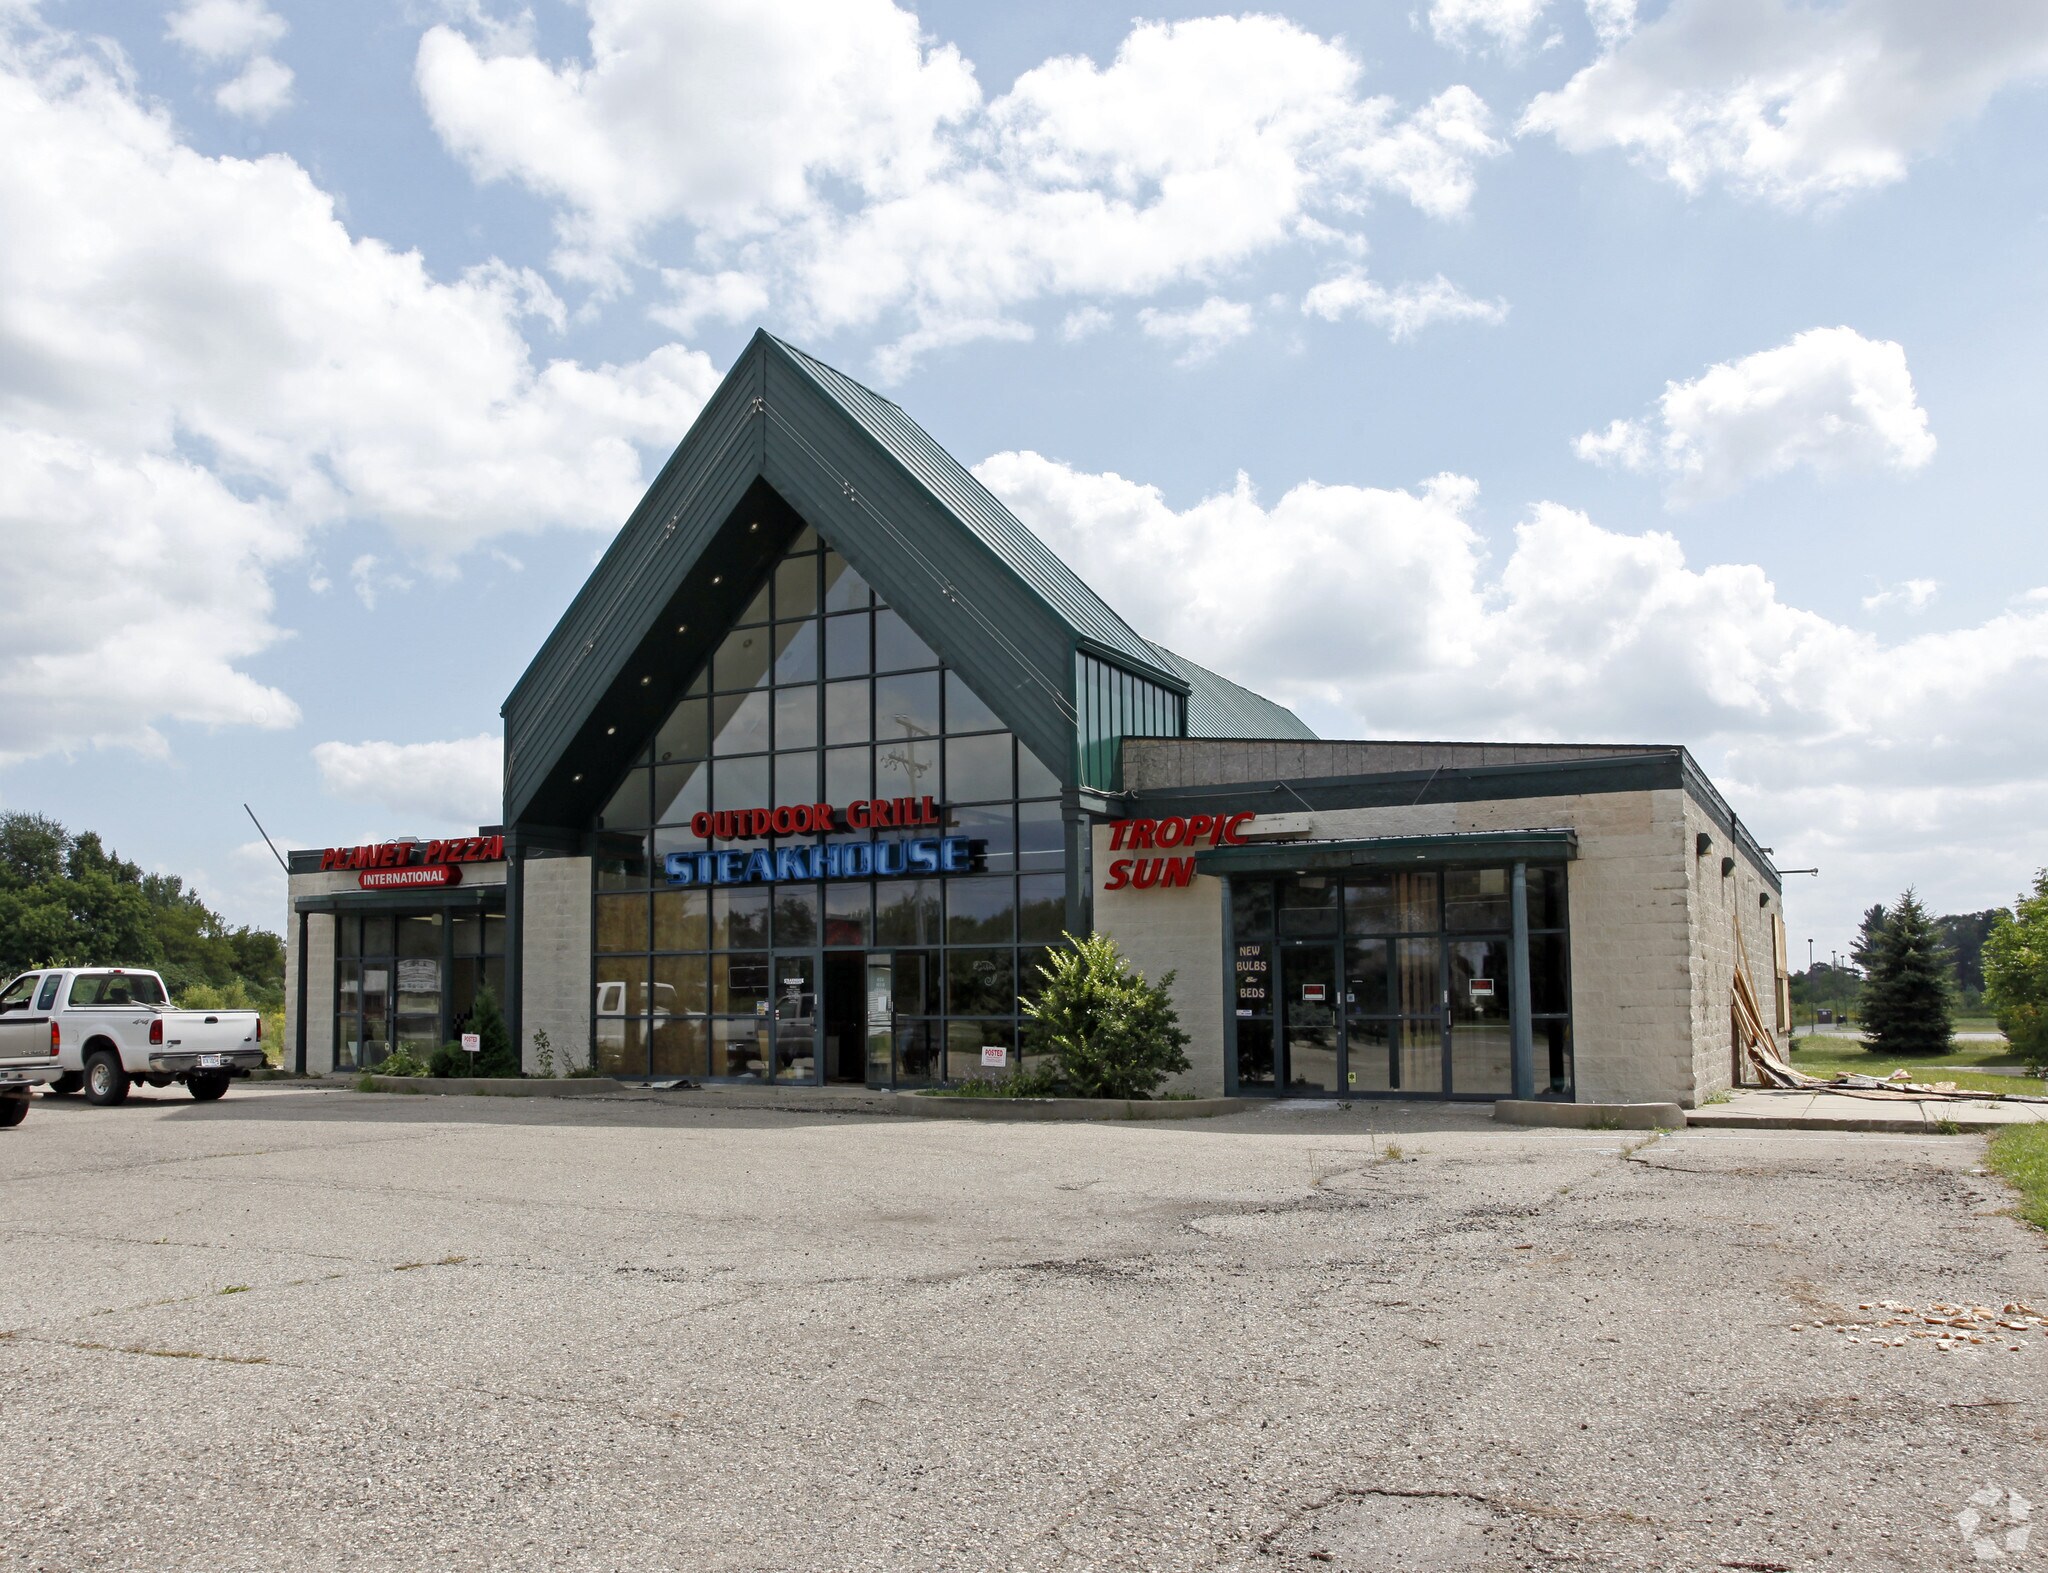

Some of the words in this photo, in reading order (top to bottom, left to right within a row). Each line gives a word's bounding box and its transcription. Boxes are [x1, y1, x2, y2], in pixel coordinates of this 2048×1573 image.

[690, 802, 834, 839] OUTDOOR
[846, 795, 939, 829] GRILL
[1108, 811, 1256, 851] TROPIC
[319, 842, 416, 871] PLANET
[423, 835, 506, 865] PIZZA
[664, 835, 971, 885] STEAKHOUSE
[363, 870, 445, 886] INTERNATIONAL
[1103, 856, 1197, 891] SUN
[1239, 946, 1260, 956] NEW
[1236, 961, 1266, 971] BULBS
[1240, 988, 1265, 998] BEDS
[984, 1049, 1004, 1057] POSTED
